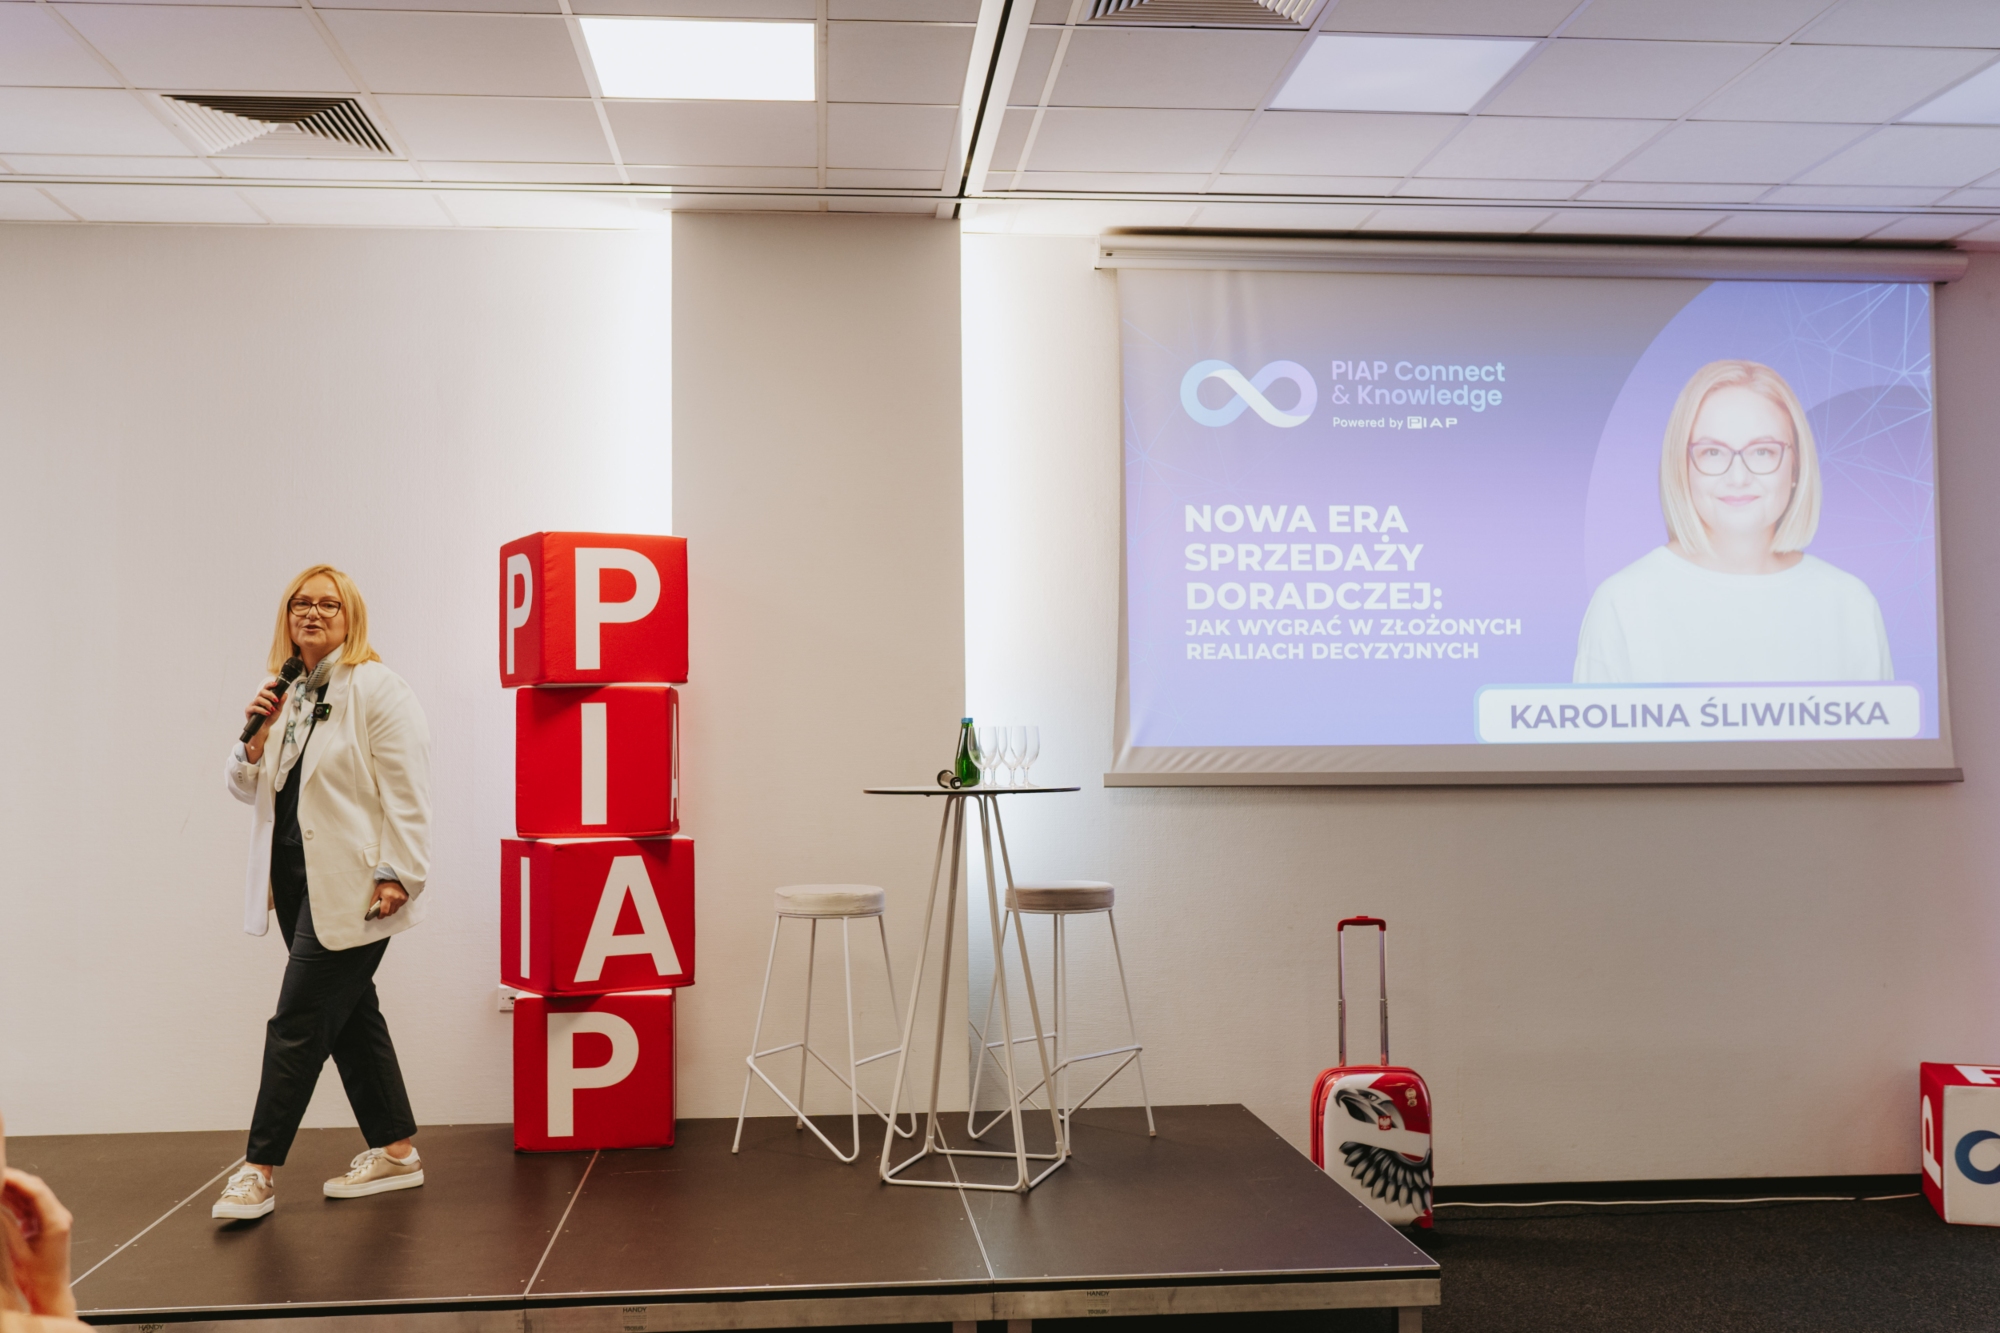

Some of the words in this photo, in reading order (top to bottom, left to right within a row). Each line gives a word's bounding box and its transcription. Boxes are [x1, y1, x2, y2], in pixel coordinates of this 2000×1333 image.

[1331, 360, 1388, 381] PIAP
[1394, 361, 1506, 382] Connect
[1331, 384, 1350, 405] &
[1357, 384, 1503, 413] Knowledge
[1333, 416, 1385, 428] Powered
[1389, 417, 1404, 430] by
[1407, 416, 1458, 429] PIAP
[1185, 504, 1317, 533] NOWA
[1328, 505, 1409, 533] ERA
[1184, 534, 1424, 571] SPRZEDAŻY
[1186, 582, 1443, 611] DORADCZEJ:
[1185, 619, 1231, 636] JAK
[1237, 615, 1342, 636] WYGRAĆ
[1348, 619, 1374, 635] W
[1380, 613, 1522, 636] ZŁOŻONYCH
[1186, 643, 1304, 660] REALIACH
[1312, 642, 1479, 660] DECYZYJNYCH
[1510, 702, 1690, 730] KAROLINA
[1700, 695, 1890, 728] ŚLIWIŃSKA
[622, 1306, 648, 1314] HANDY
